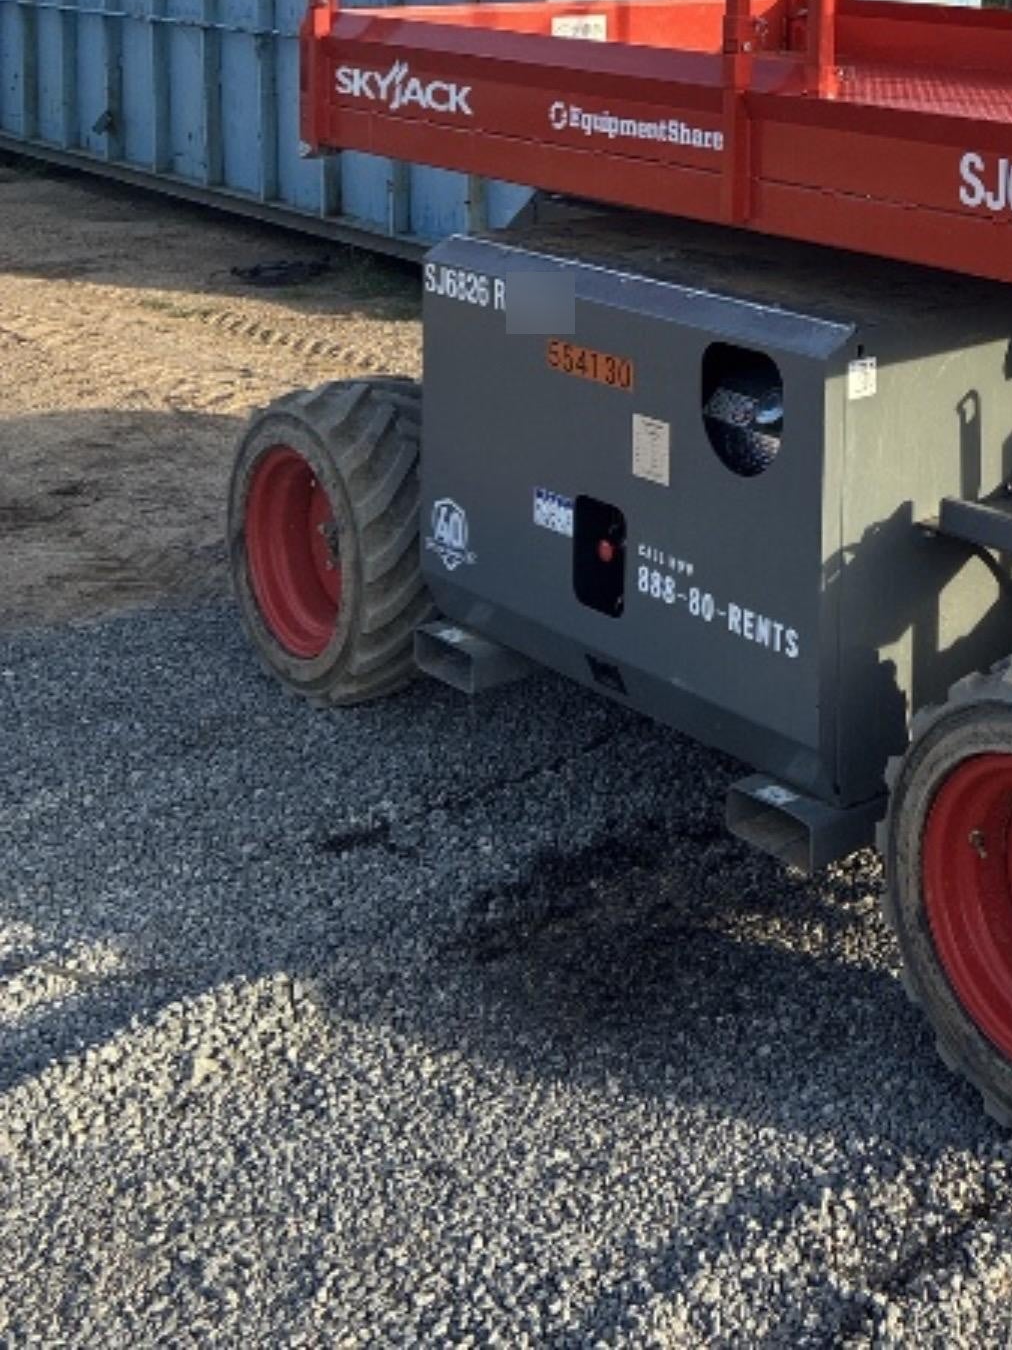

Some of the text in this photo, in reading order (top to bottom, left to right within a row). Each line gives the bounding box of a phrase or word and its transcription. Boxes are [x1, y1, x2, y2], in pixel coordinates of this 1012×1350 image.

[335, 59, 473, 115] SKYJACK
[569, 105, 725, 151] EquipmentShare
[424, 262, 507, 312] SJ6826 R
[547, 339, 632, 388] 554130
[637, 565, 800, 659] 888-80-RENTS
